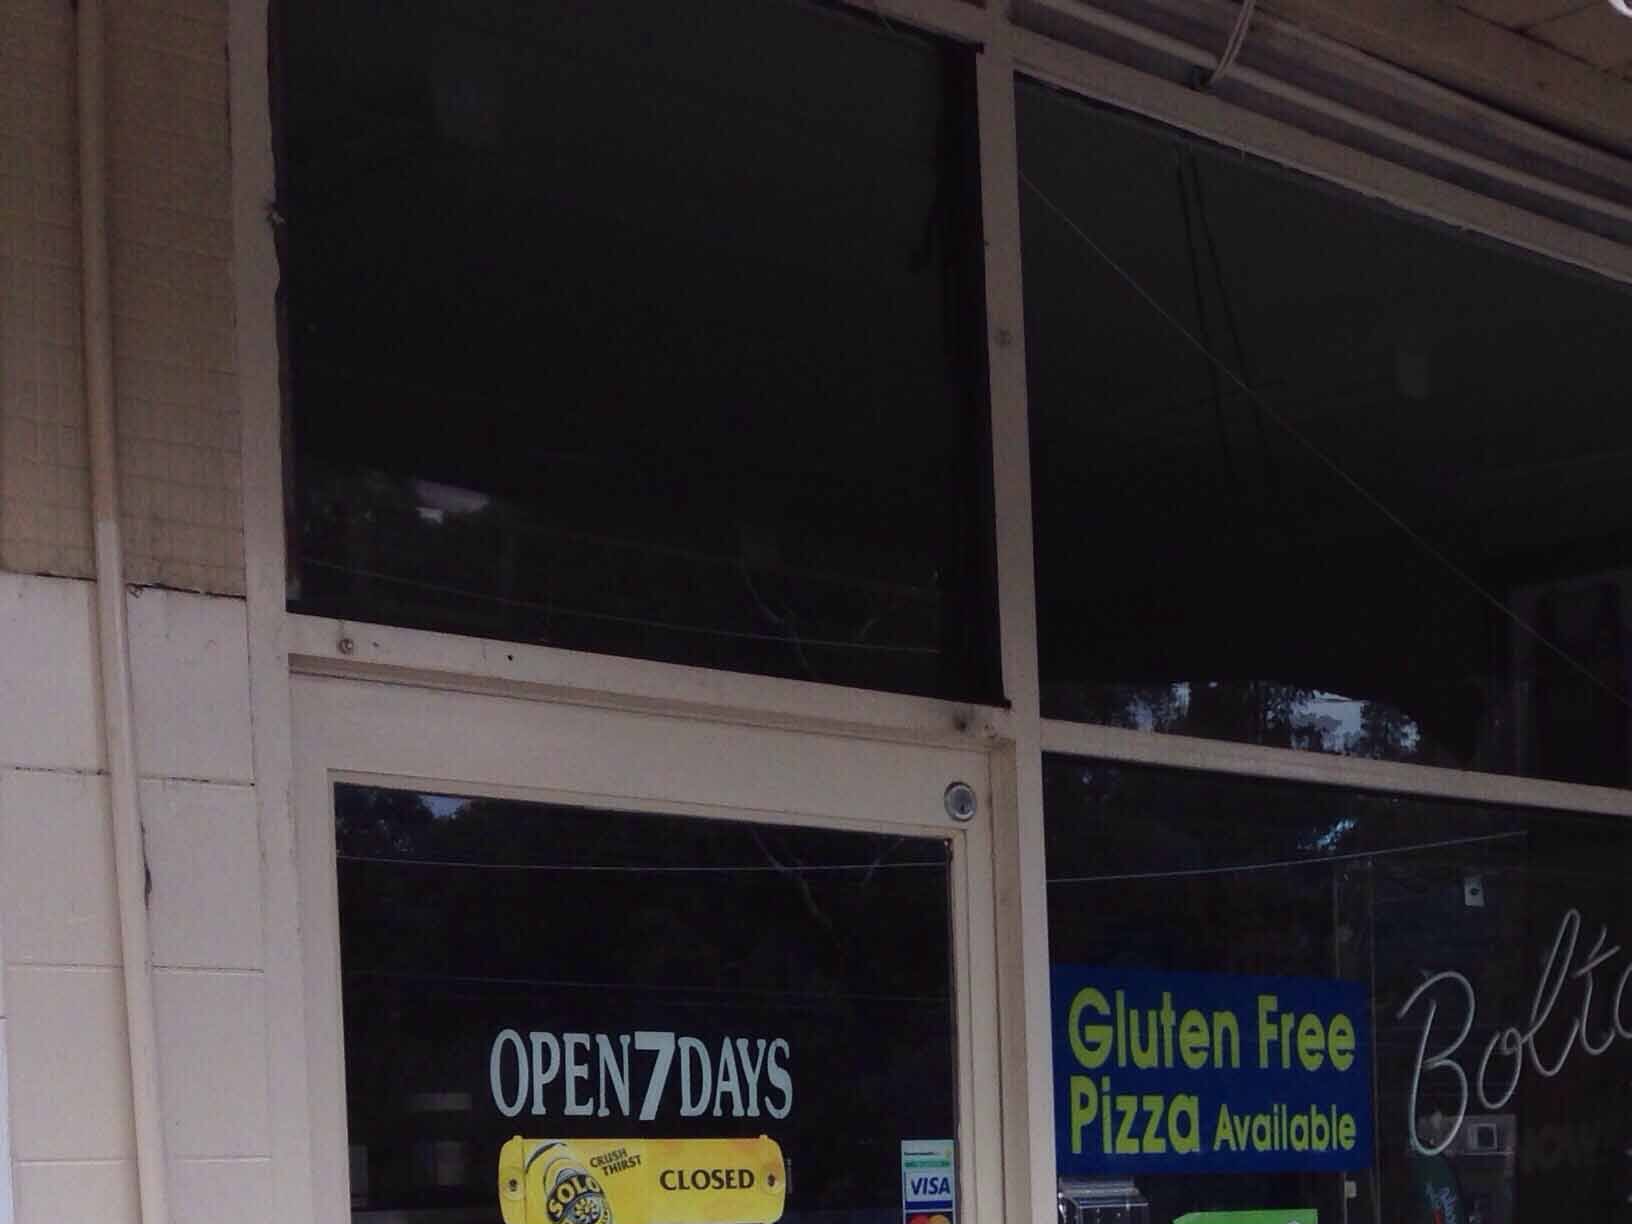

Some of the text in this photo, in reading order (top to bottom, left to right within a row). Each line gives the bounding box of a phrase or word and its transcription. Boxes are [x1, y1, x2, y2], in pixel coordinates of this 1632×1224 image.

[1068, 986, 1357, 1072] Gluten Free
[1068, 1074, 1357, 1154] Pizza Available
[589, 1148, 628, 1168] CRUSH
[602, 1153, 642, 1177] THIRST
[659, 1168, 755, 1191] CLOSED
[910, 1176, 951, 1195] VISA
[547, 1173, 602, 1219] SOLO
